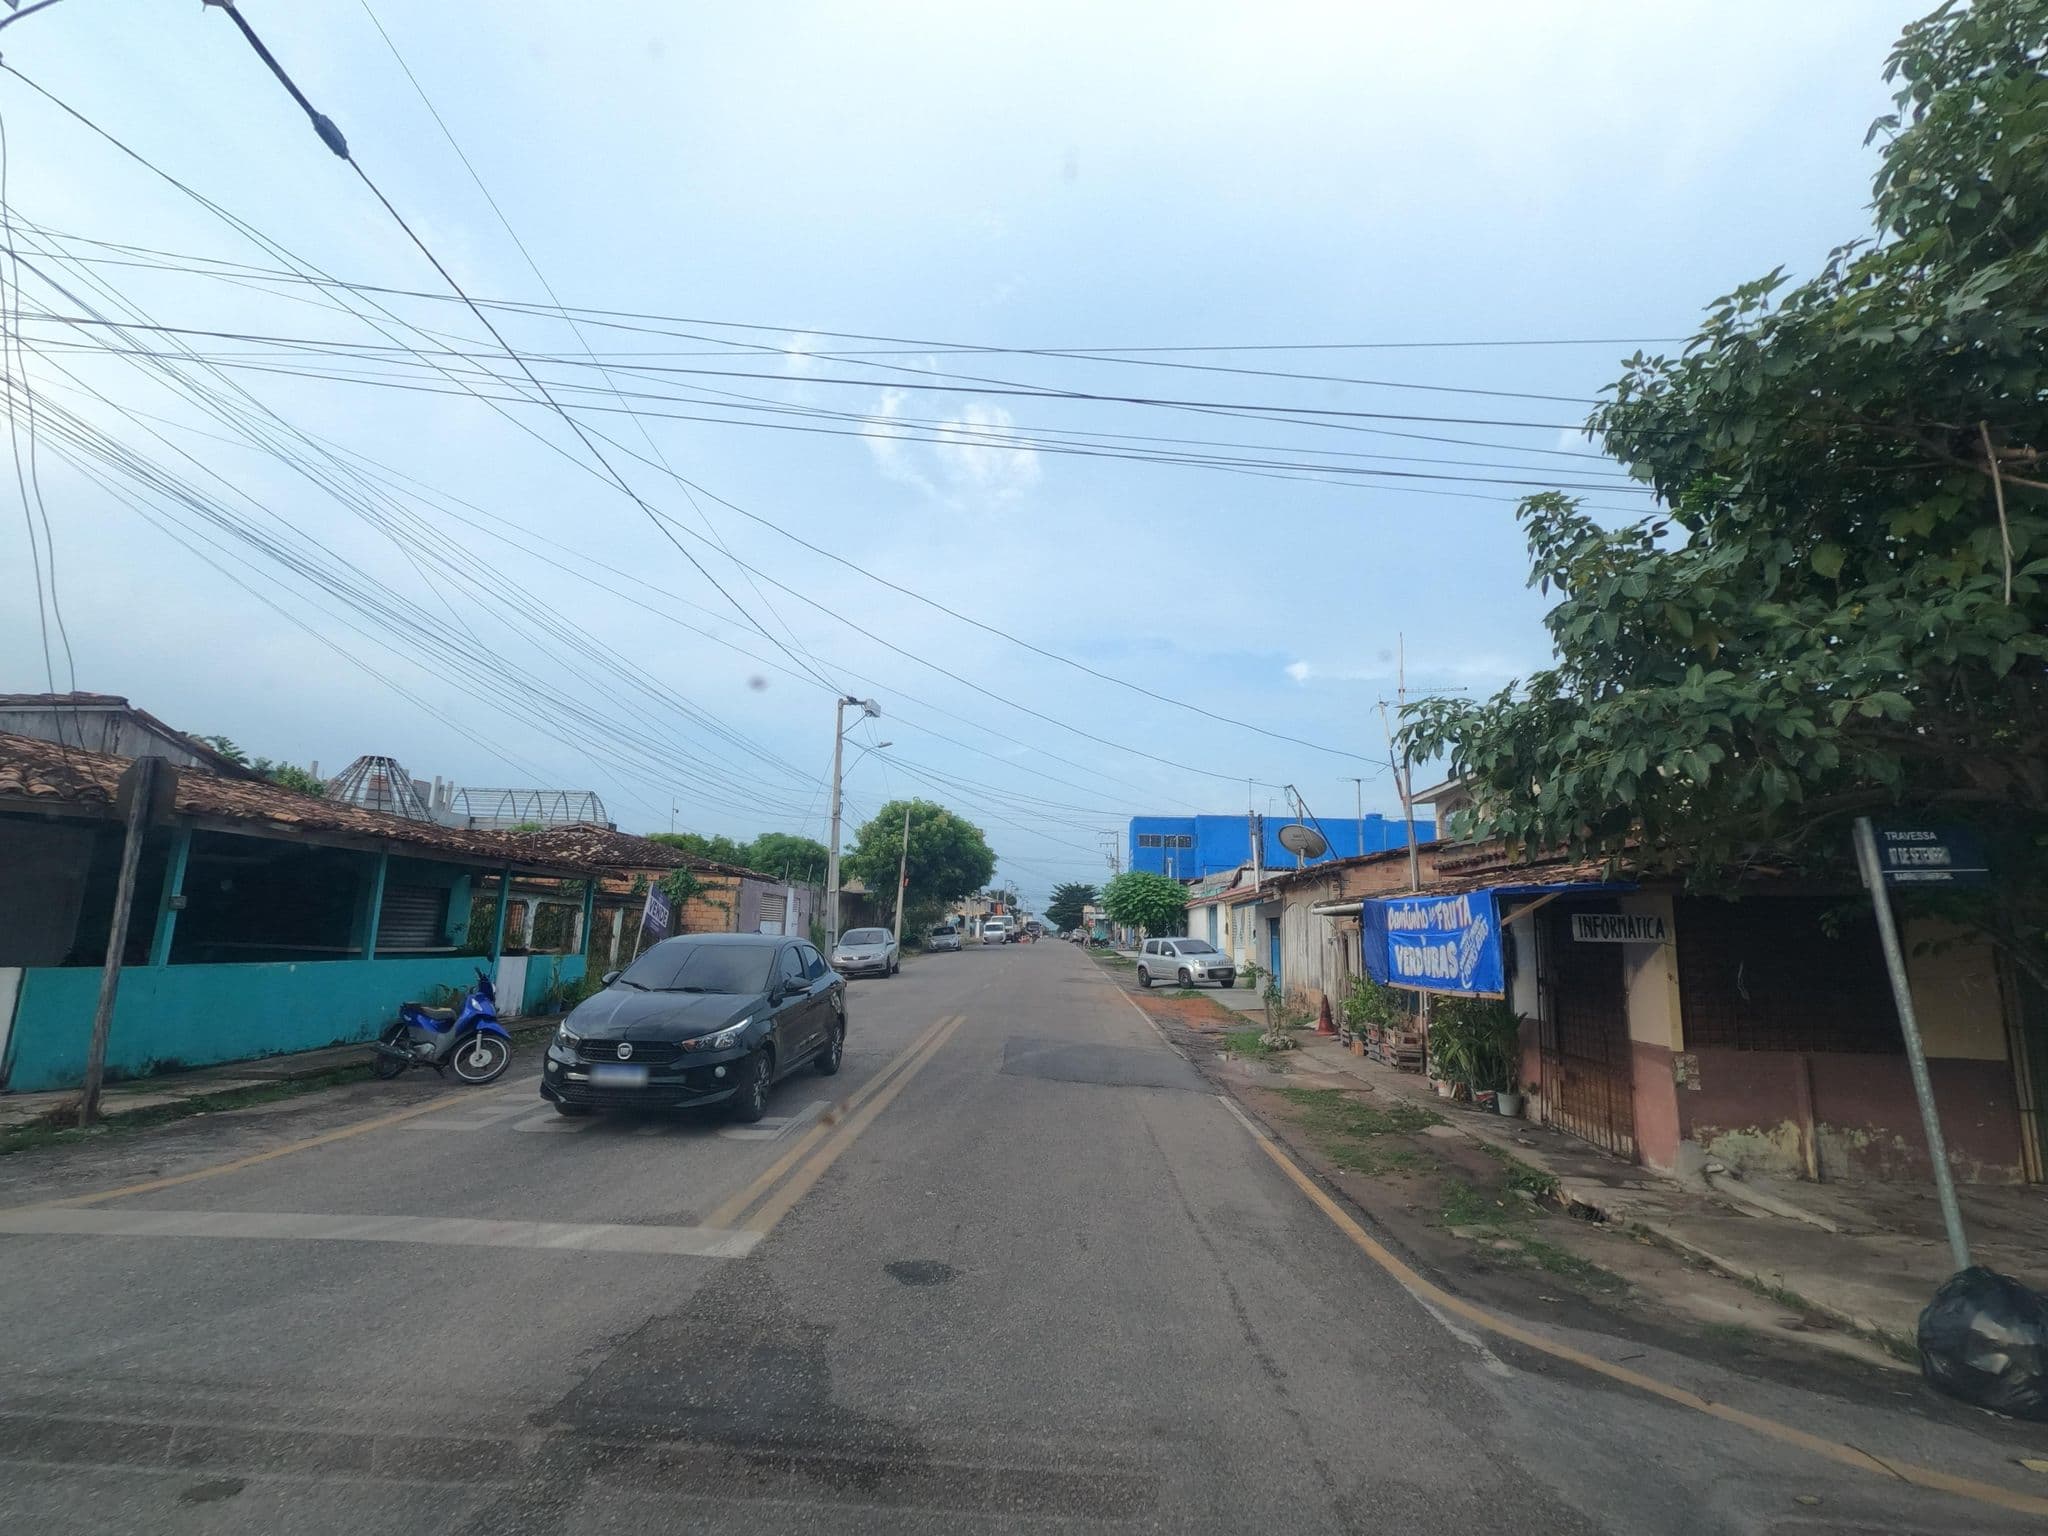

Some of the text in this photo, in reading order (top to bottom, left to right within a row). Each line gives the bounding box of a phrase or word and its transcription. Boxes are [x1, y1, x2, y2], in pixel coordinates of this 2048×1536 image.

[1884, 831, 1937, 841] TRAVESSA
[1435, 895, 1472, 929] FRUTA
[1395, 941, 1458, 979] VERDURAS
